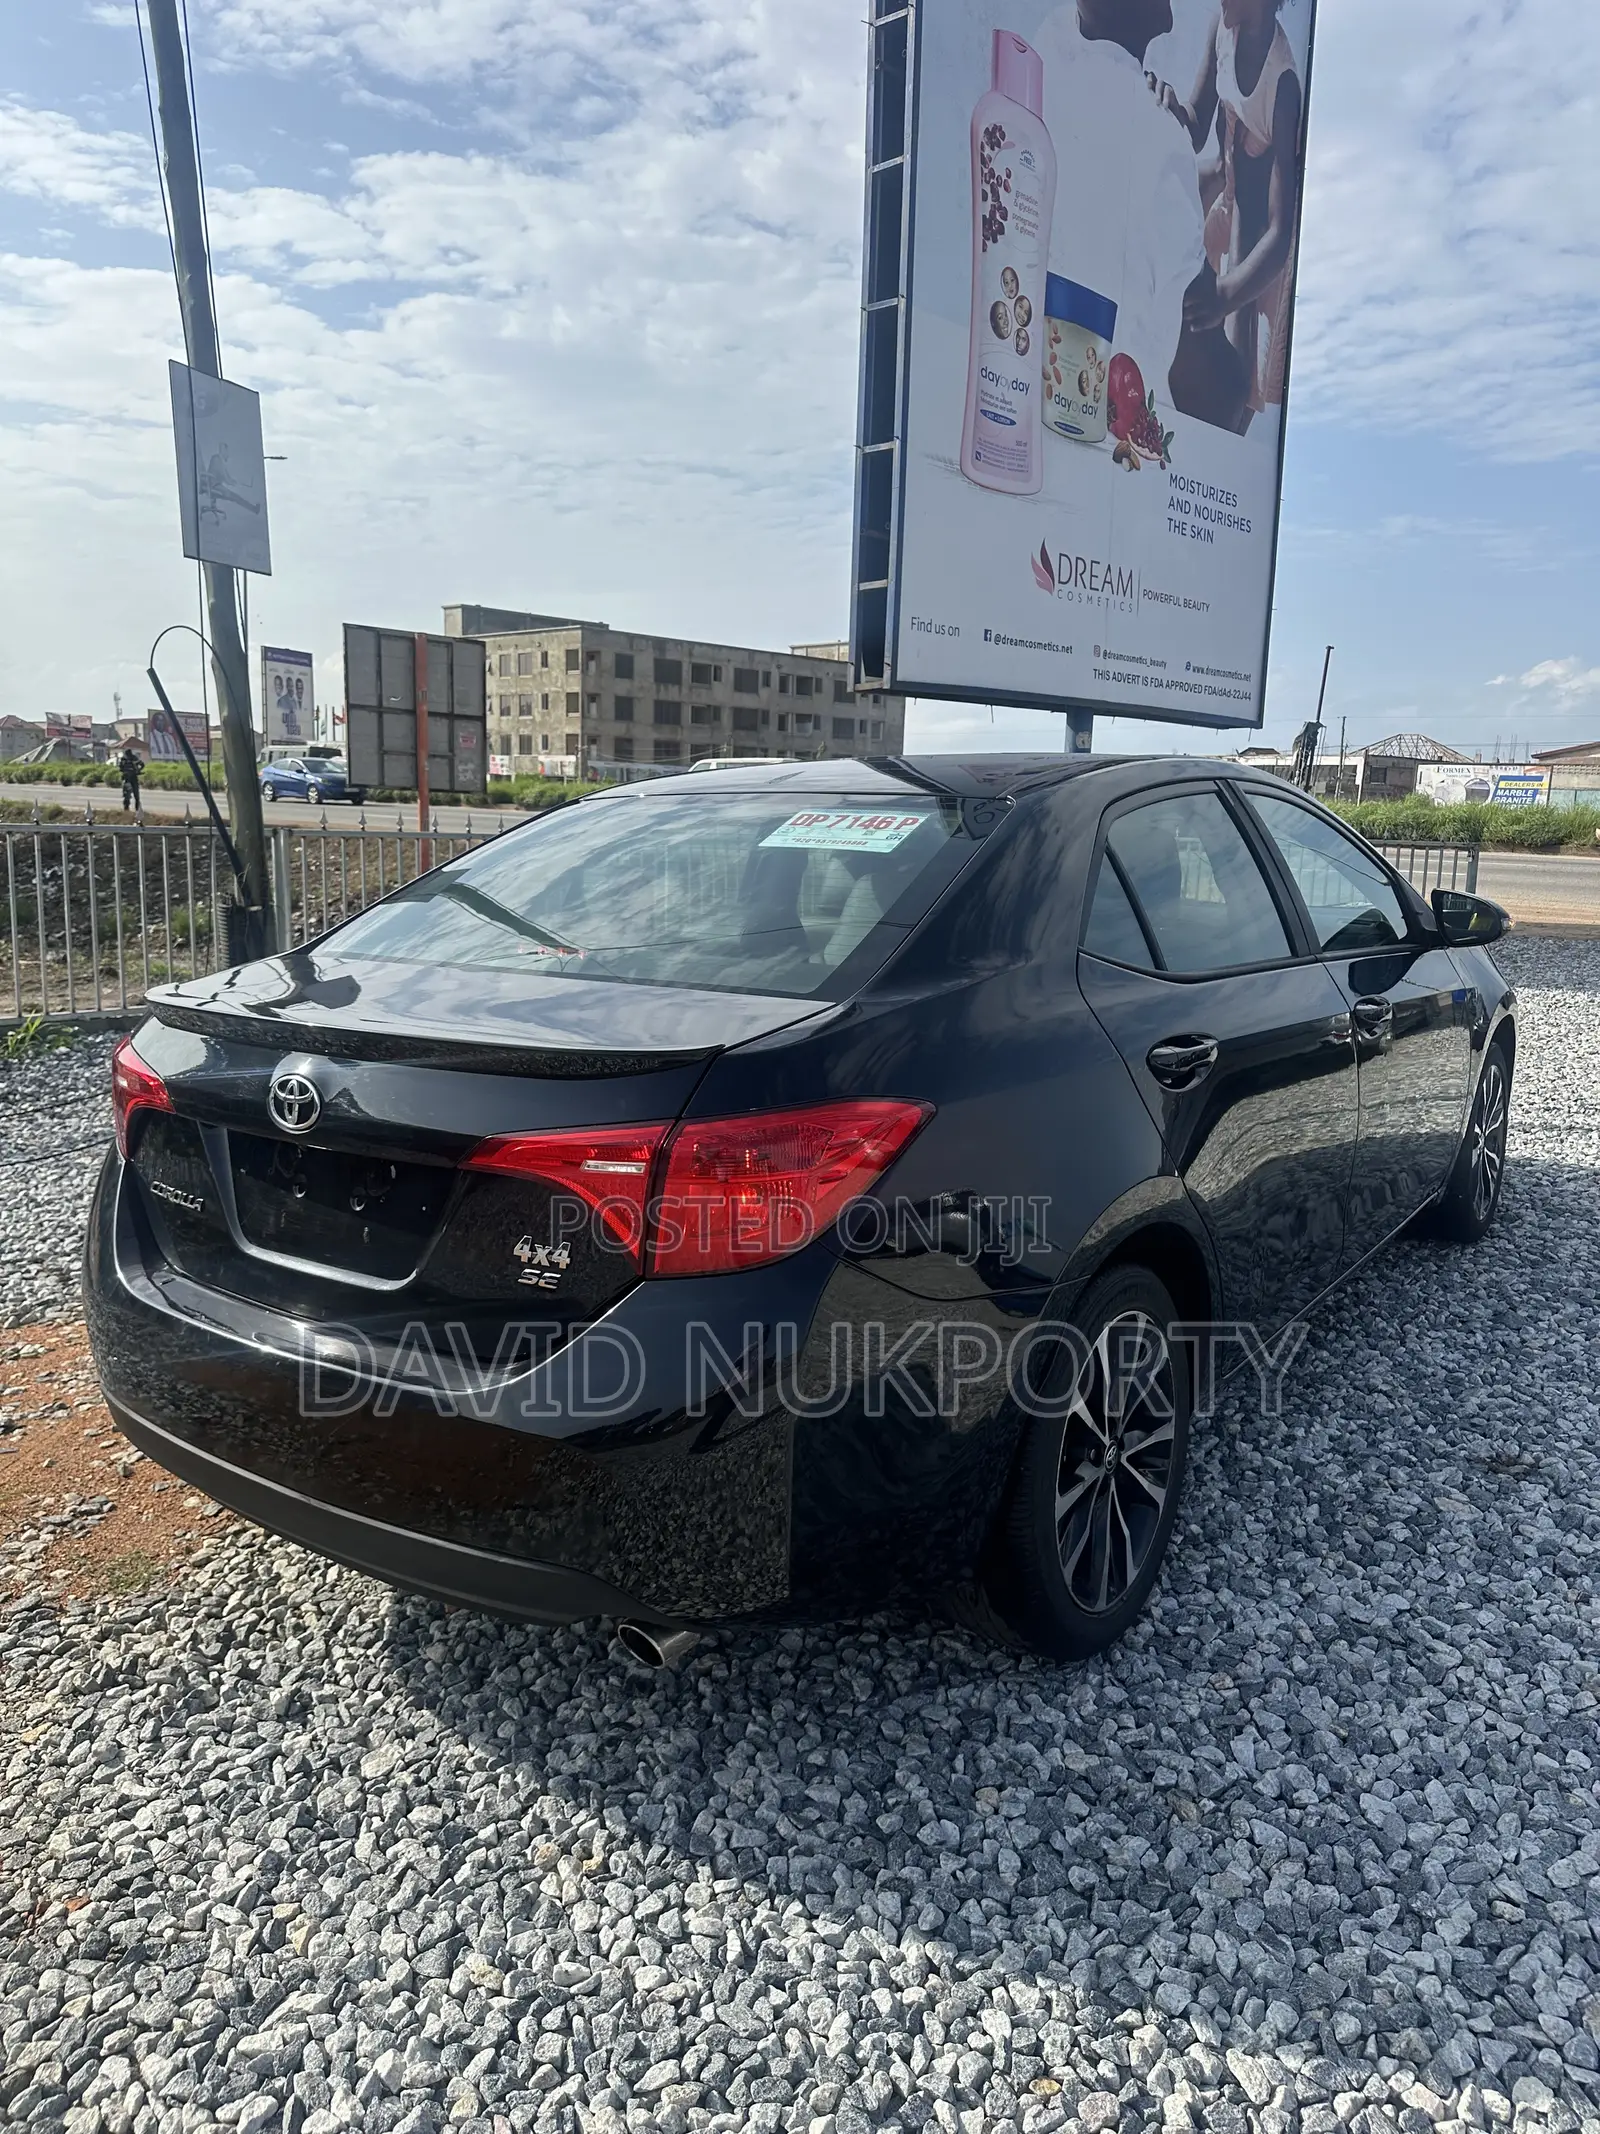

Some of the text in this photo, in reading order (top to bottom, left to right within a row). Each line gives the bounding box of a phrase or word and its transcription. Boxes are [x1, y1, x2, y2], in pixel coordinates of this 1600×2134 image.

[1169, 473, 1238, 508] MOISTURIZES
[1168, 496, 1251, 533] AND NOURISHES
[1167, 517, 1214, 544] THE SKIN
[1058, 552, 1133, 599] DREAM
[1057, 589, 1133, 613] COSMETICS
[1143, 588, 1210, 613] POWERFUL BEAUTY
[911, 616, 960, 638] Find us on
[994, 633, 1073, 654] @dreamcosmetics.net
[1102, 649, 1167, 670] @dreamcosmetics_beauty
[1093, 668, 1111, 681] THIS
[1112, 671, 1140, 686] ADVERT
[1141, 675, 1149, 687] IS
[1150, 677, 1164, 689] FDA
[1165, 680, 1202, 695] APPROVED
[1192, 664, 1252, 682] www.dreamcosmetics.net
[789, 814, 919, 830] DP 7146 P
[150, 1180, 204, 1212] COROLLA
[513, 1234, 571, 1269] 4x4
[517, 1268, 562, 1290] SE
